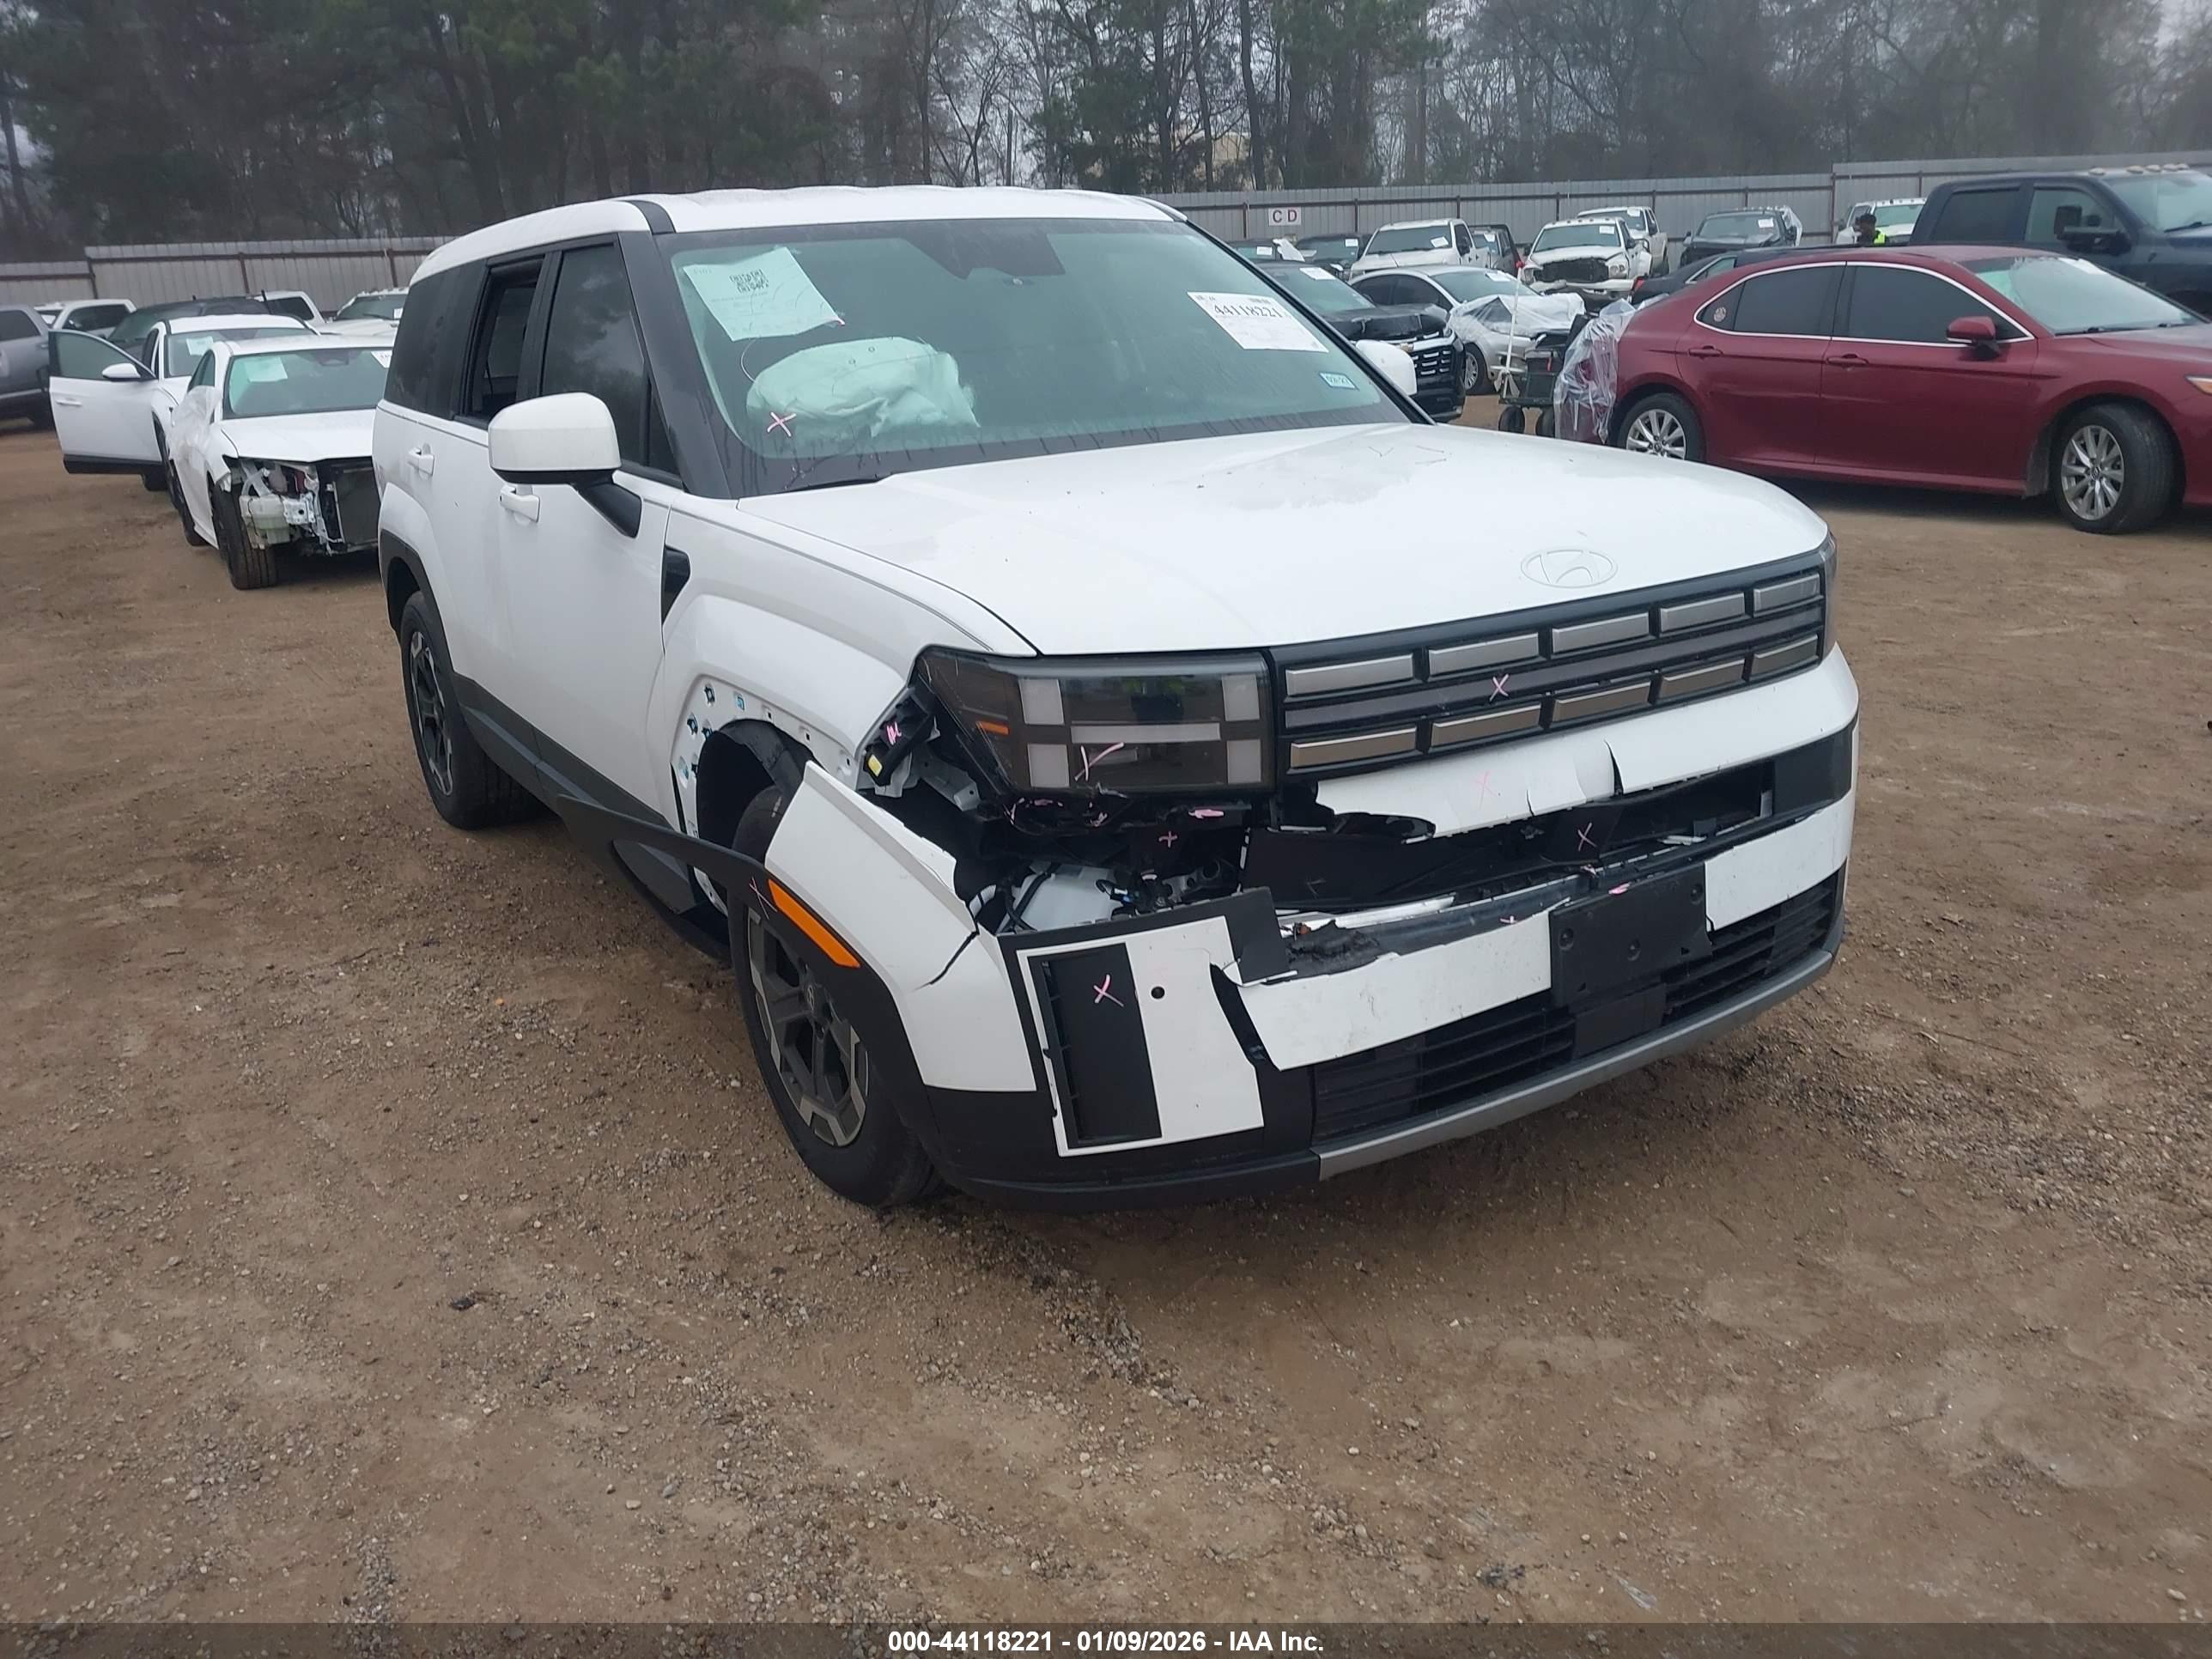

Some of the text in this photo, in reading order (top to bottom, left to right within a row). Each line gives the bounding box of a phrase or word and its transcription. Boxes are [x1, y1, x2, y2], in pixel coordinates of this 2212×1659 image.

[1273, 210, 1297, 222] C D
[1213, 304, 1283, 318] 44118221
